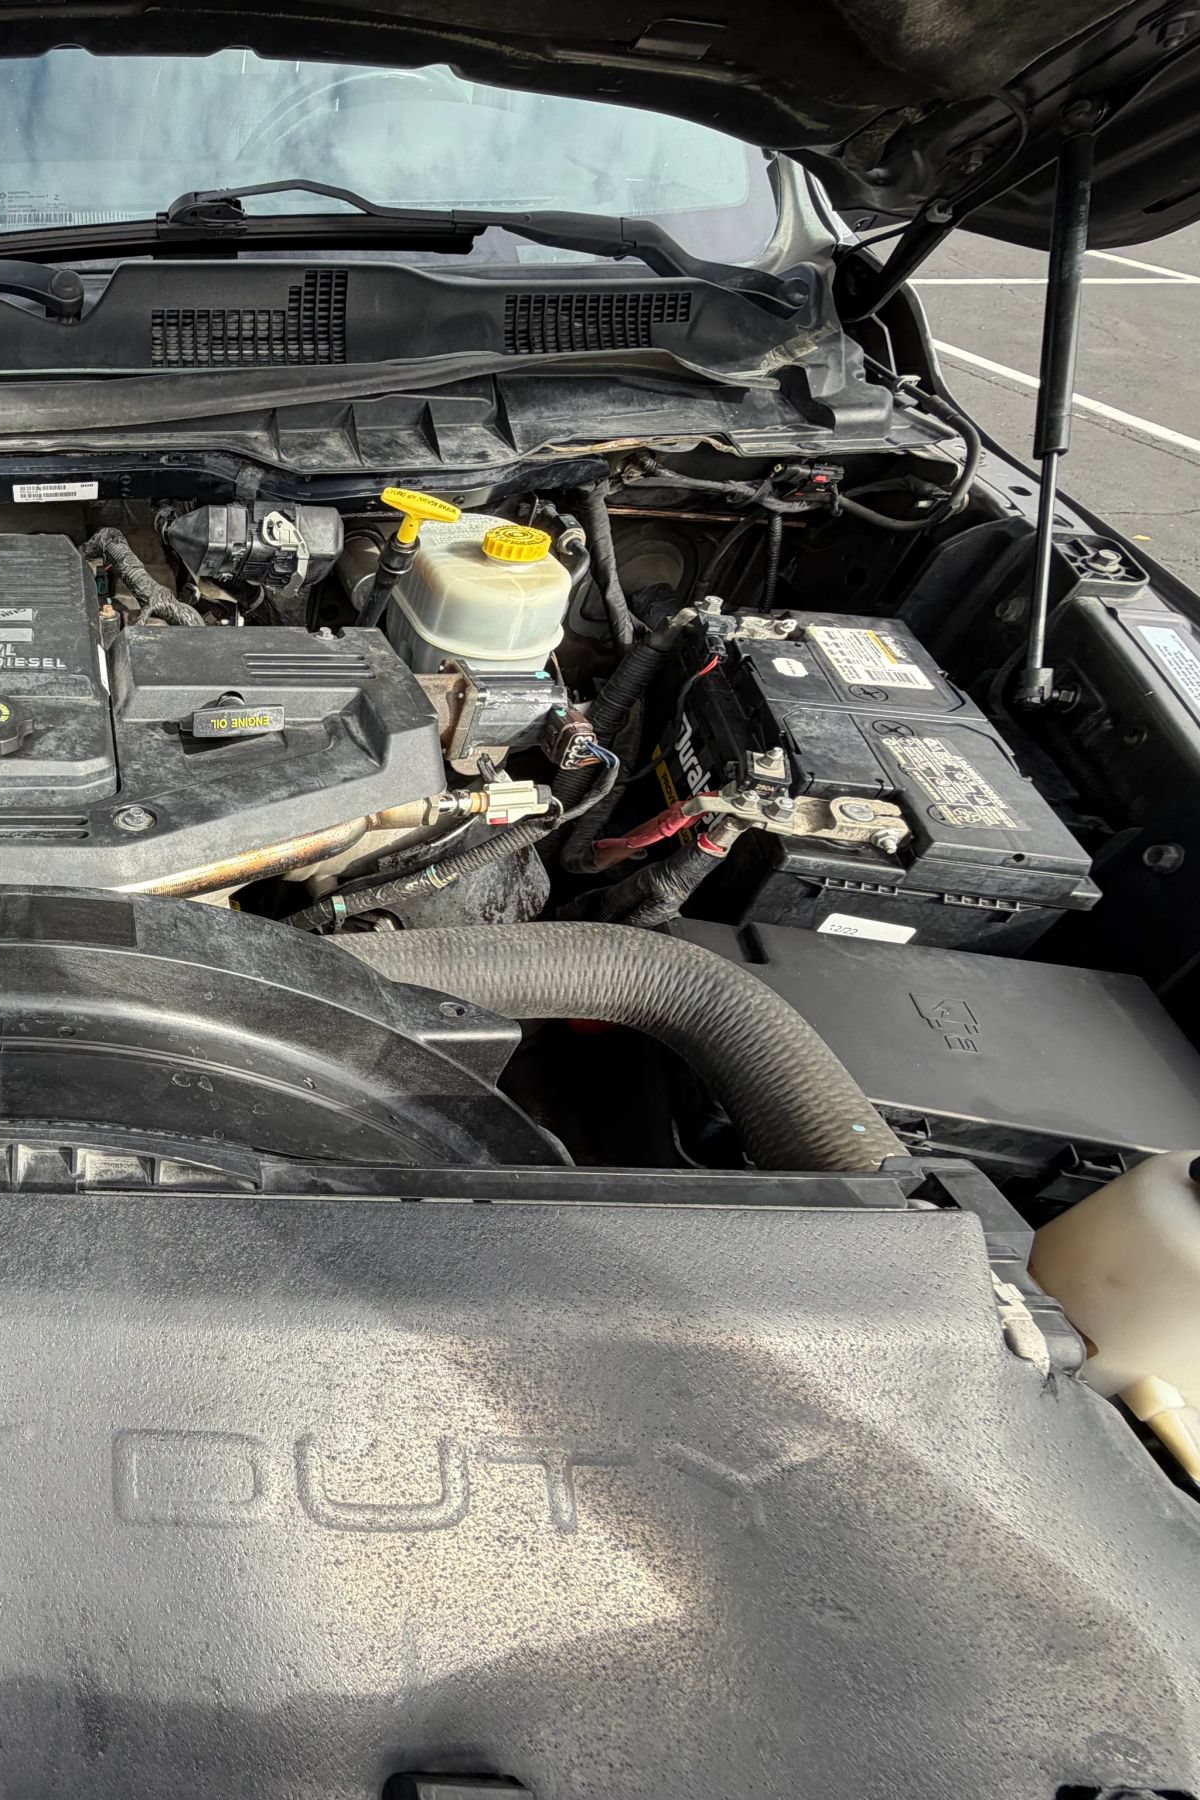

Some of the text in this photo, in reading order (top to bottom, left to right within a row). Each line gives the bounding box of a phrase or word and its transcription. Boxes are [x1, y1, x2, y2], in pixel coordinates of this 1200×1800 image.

[211, 716, 270, 729] ENGINE OIL
[112, 1427, 826, 1533] DUTY
